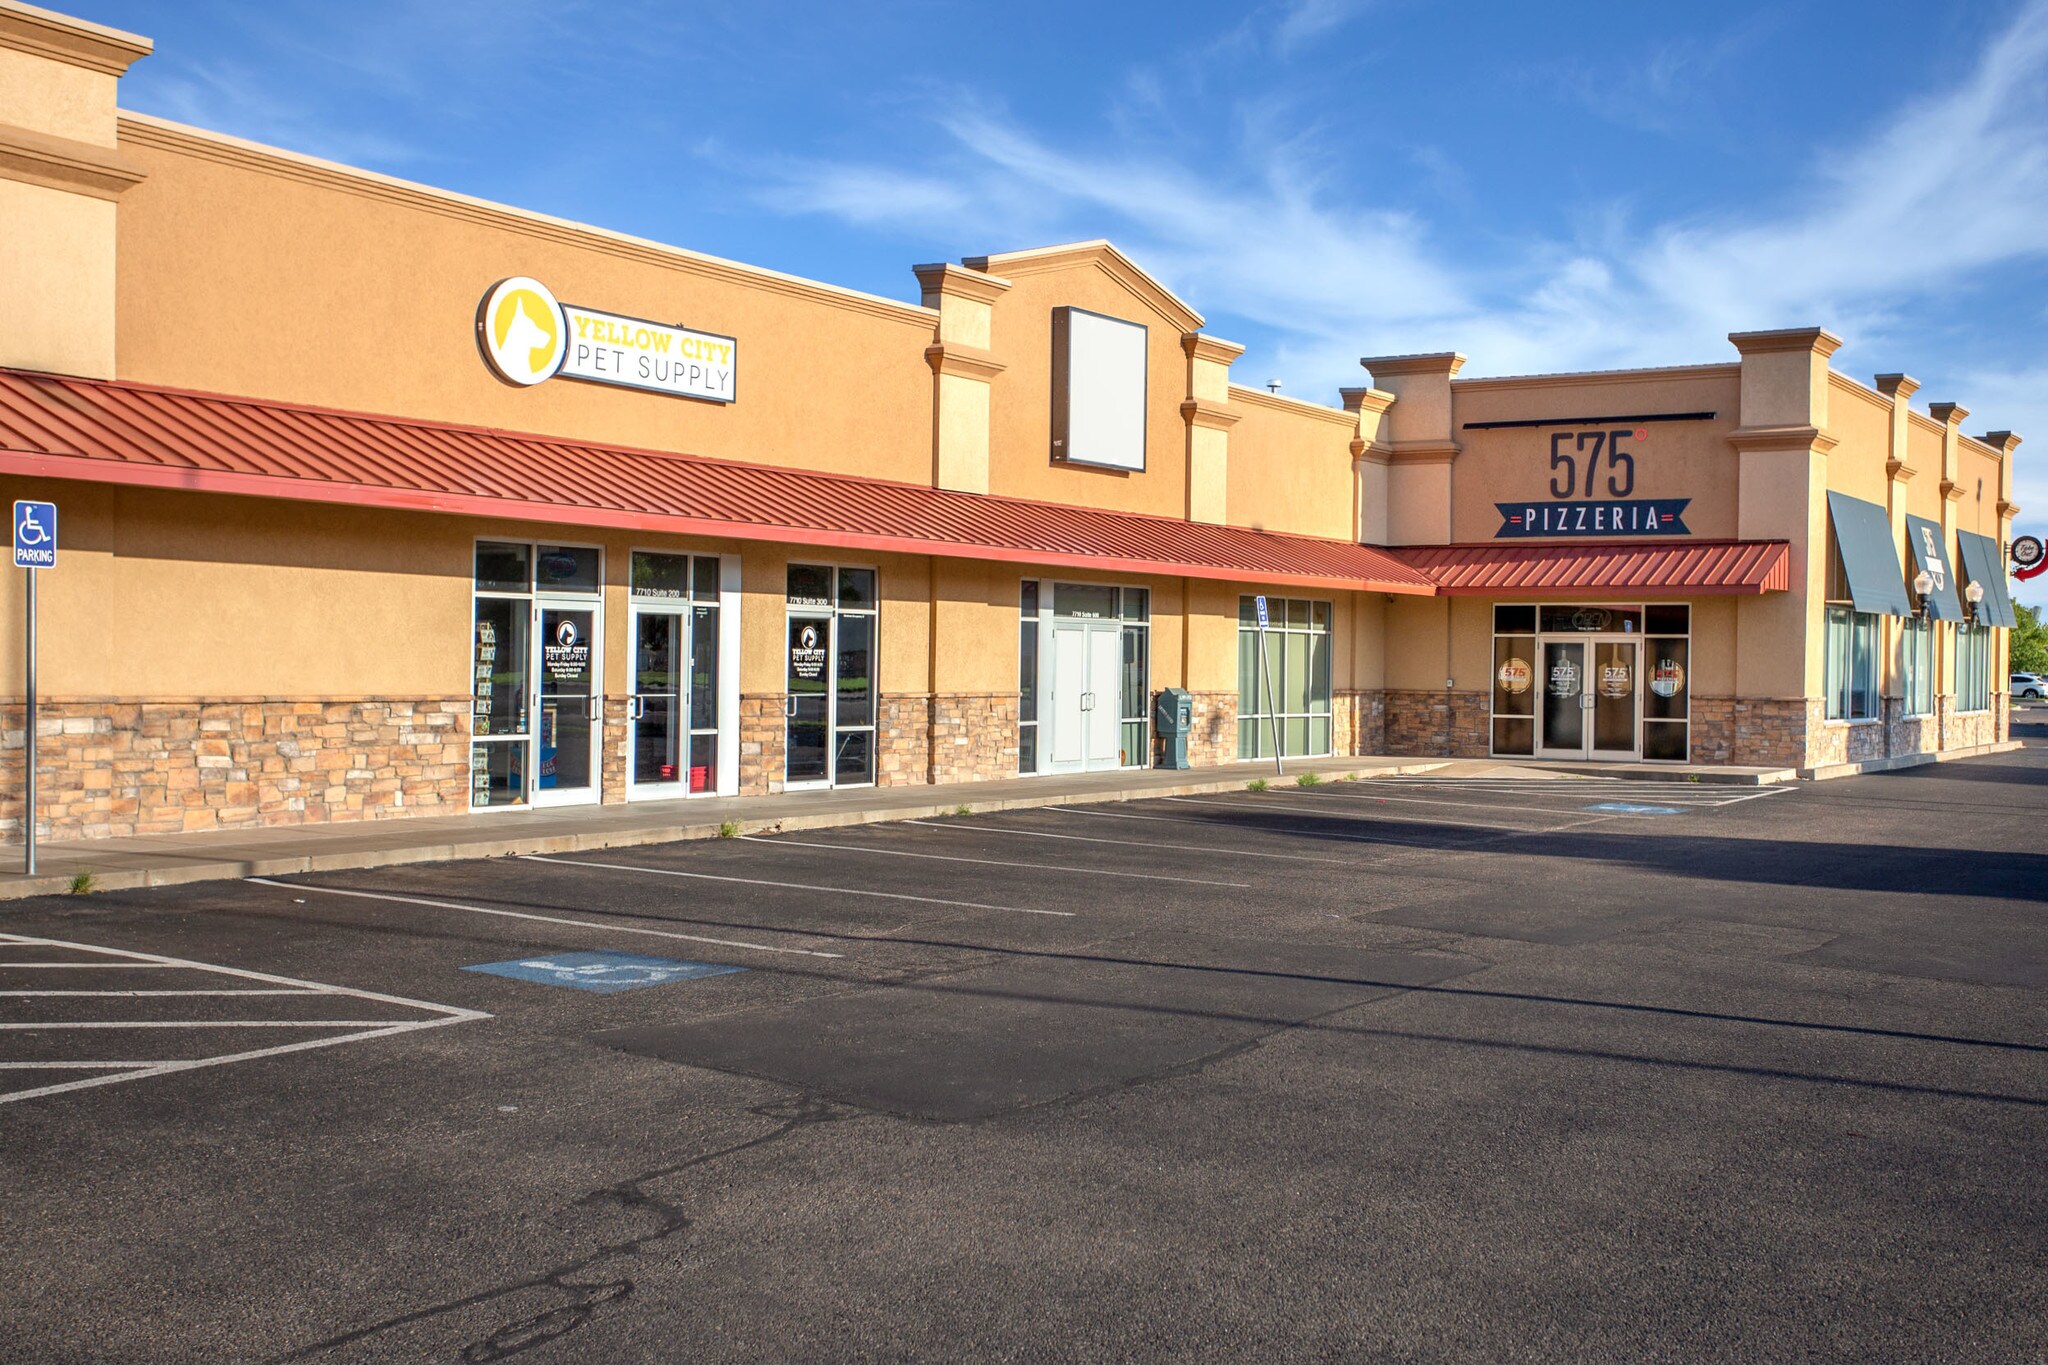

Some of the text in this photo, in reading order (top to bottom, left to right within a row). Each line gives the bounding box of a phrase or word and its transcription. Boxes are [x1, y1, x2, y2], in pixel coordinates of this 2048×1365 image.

[574, 316, 732, 365] YELLOW CITY
[578, 344, 729, 391] PET SUPPLY
[1525, 506, 1658, 531] PIZZERIA
[17, 548, 52, 562] PARKING
[636, 588, 651, 596] 7710
[652, 588, 667, 597] Suite
[573, 646, 589, 654] CITY
